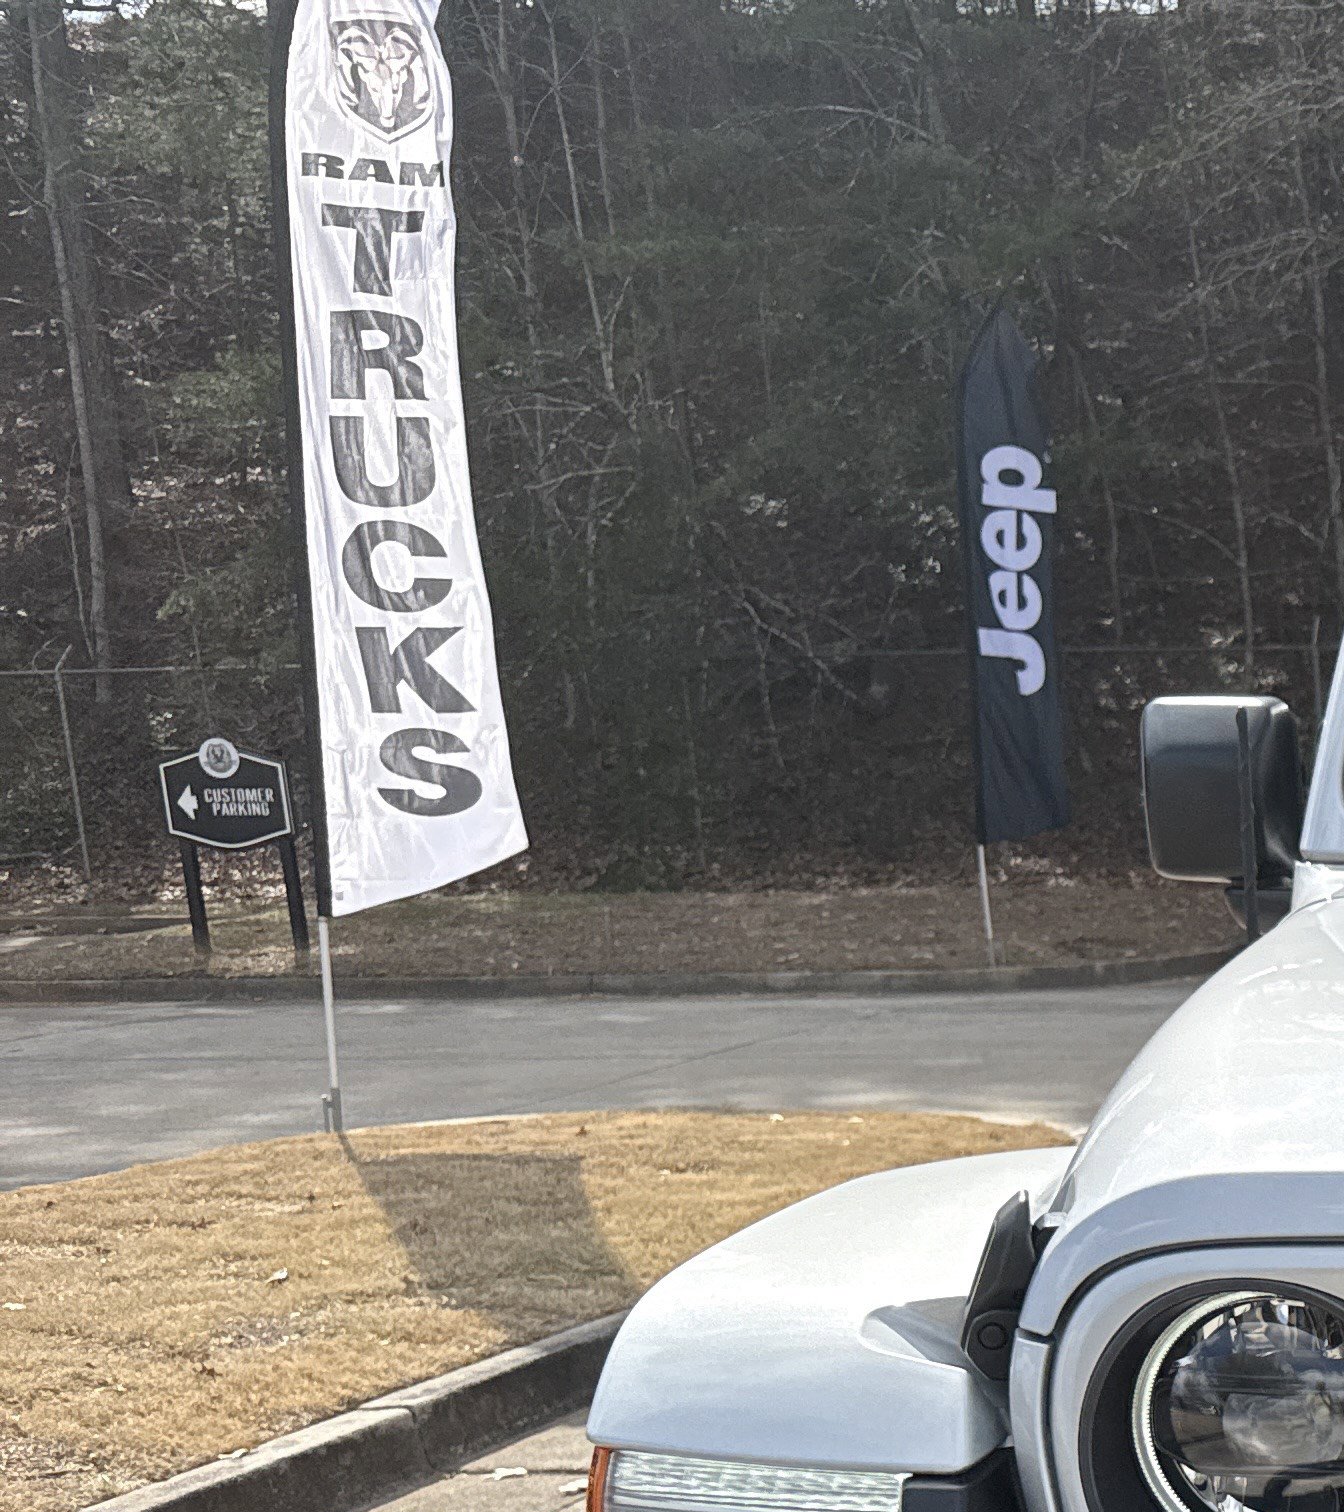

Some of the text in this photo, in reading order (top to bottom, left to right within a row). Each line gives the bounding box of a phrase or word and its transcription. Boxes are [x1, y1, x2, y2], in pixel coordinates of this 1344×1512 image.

[300, 152, 446, 188] RAM
[321, 203, 483, 818] TRUCKS
[976, 444, 1057, 696] Jeep
[203, 787, 275, 803] CUSTOMER
[212, 801, 270, 817] PARKING
